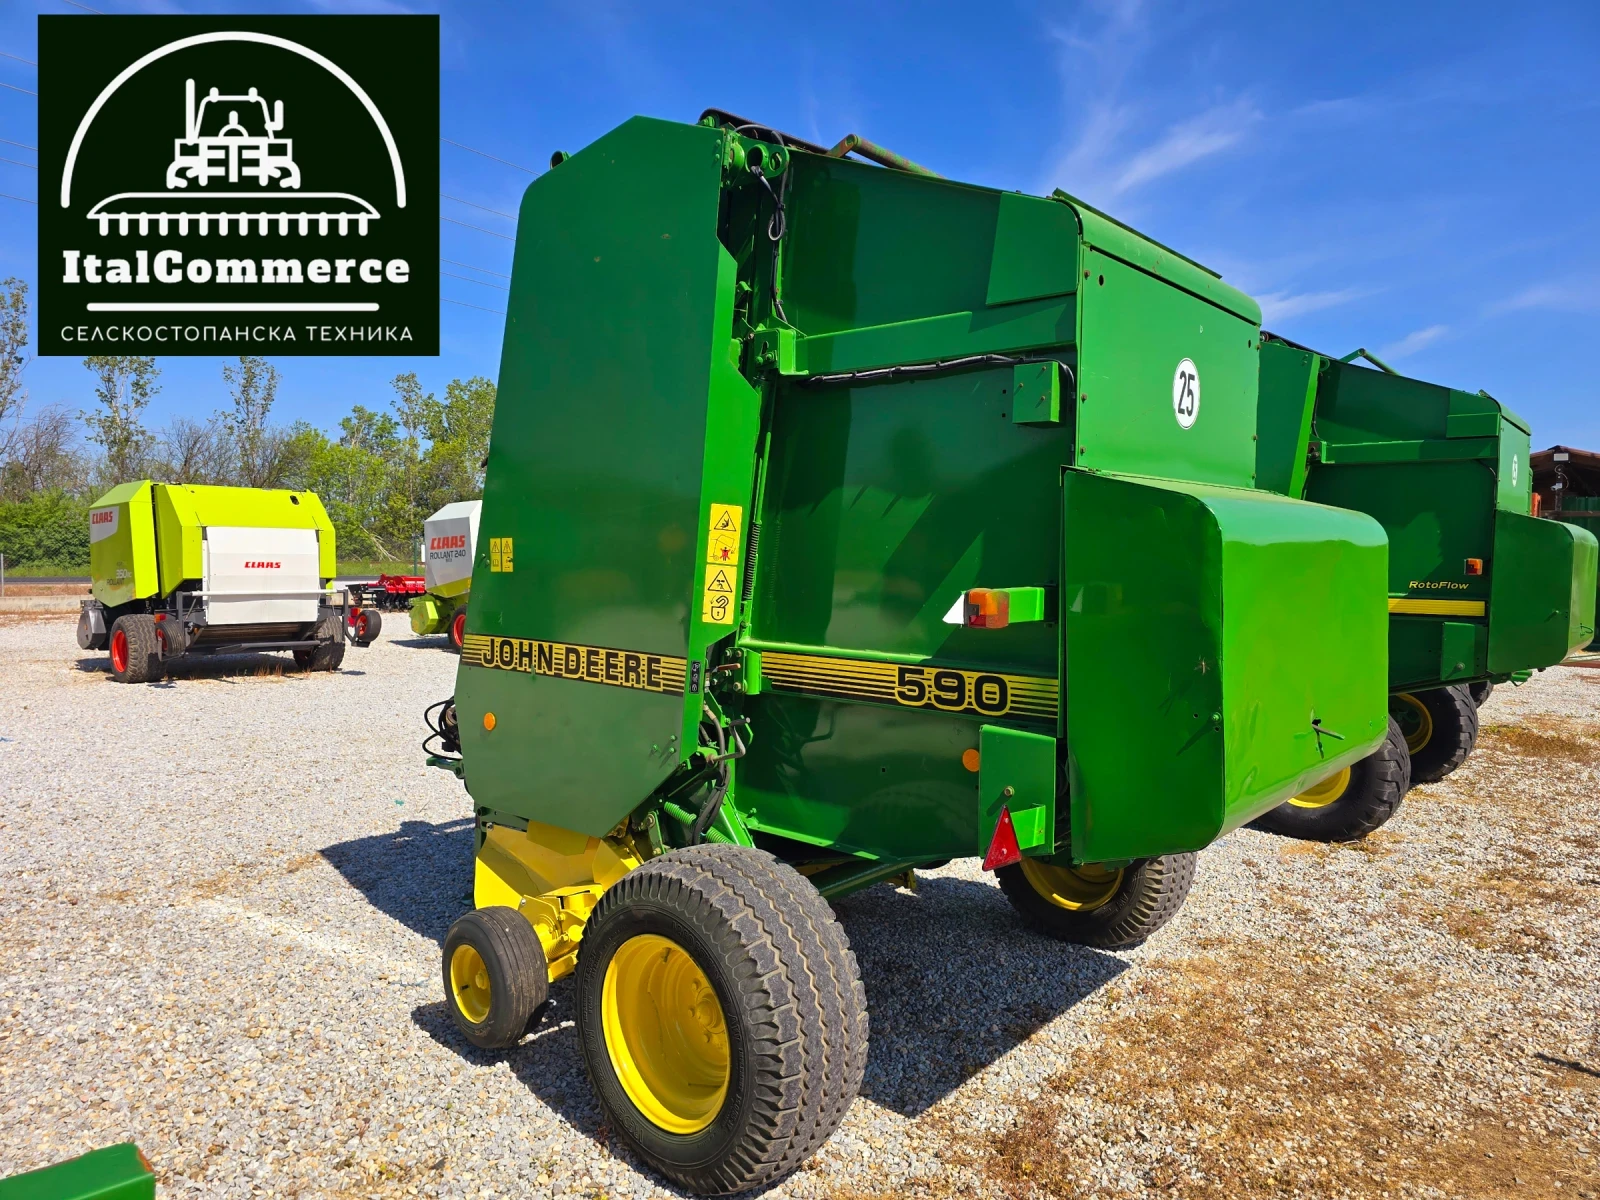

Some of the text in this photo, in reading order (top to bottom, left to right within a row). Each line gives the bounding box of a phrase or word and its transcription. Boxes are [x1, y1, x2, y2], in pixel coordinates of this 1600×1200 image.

[1177, 370, 1196, 417] 25
[92, 511, 113, 525] CLAAS
[430, 534, 466, 551] CLAAS
[430, 549, 467, 560] ROLLANT 240
[244, 561, 282, 569] CLAAS
[1408, 580, 1470, 590] RotoFlow
[482, 637, 664, 692] JOHN DEERE
[894, 665, 1012, 716] 590
